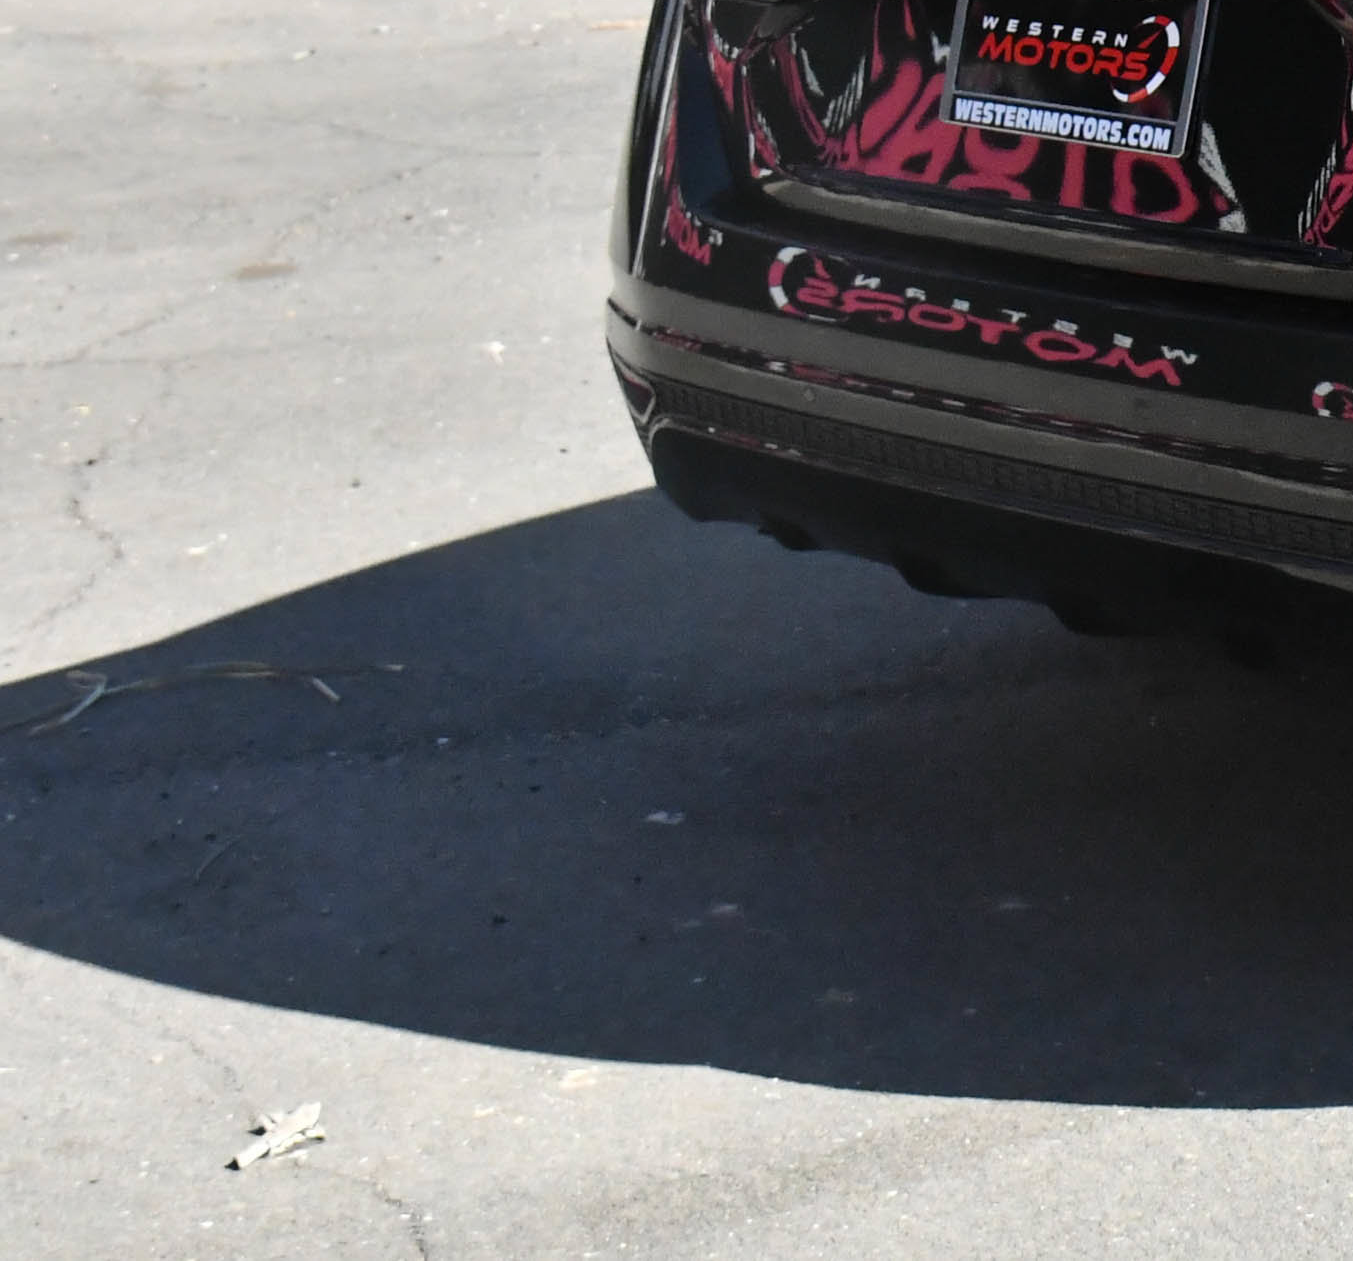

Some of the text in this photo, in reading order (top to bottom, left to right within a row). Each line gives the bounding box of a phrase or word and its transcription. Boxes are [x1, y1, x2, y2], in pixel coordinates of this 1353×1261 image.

[981, 15, 1129, 48] WESTERN
[978, 32, 1152, 82] MOTORS
[953, 98, 1172, 151] WESTERNMOTORS.COM
